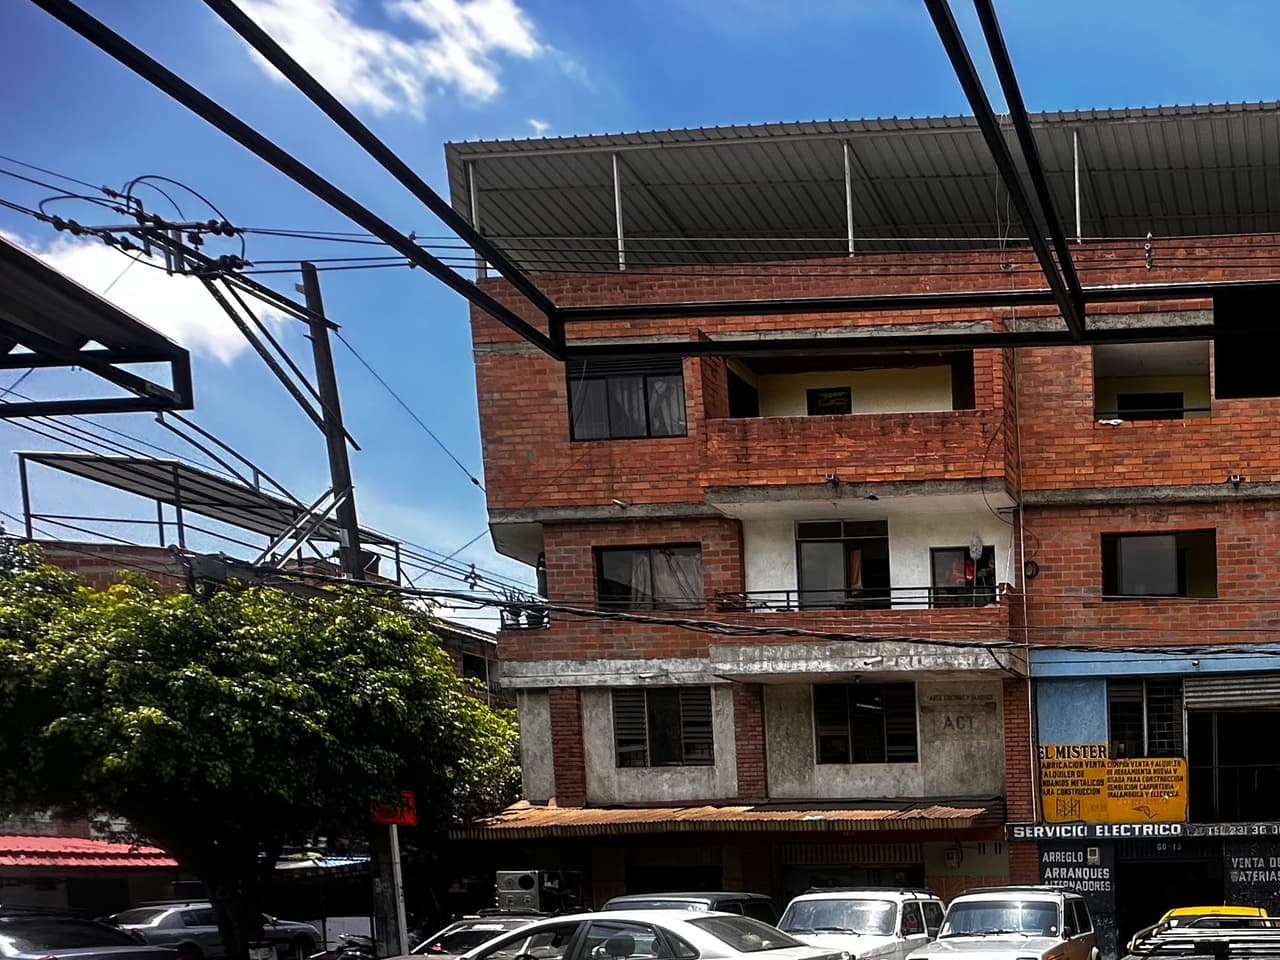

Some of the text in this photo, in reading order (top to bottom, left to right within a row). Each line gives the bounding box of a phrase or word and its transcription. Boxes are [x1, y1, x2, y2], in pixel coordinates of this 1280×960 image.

[1040, 745, 1107, 760] EL MISTER
[1041, 761, 1106, 769] ABRICACION VENTA
[1044, 770, 1084, 778] ALQUILER DE
[1041, 779, 1069, 787] NDAMIOS
[1041, 787, 1055, 796] ARA
[1013, 825, 1088, 838] SERVICIO
[1096, 824, 1181, 837] ELECTRICO
[1042, 851, 1083, 862] ARREGLO
[1231, 857, 1265, 868] VENTA
[1044, 867, 1110, 880] ARRANQUES
